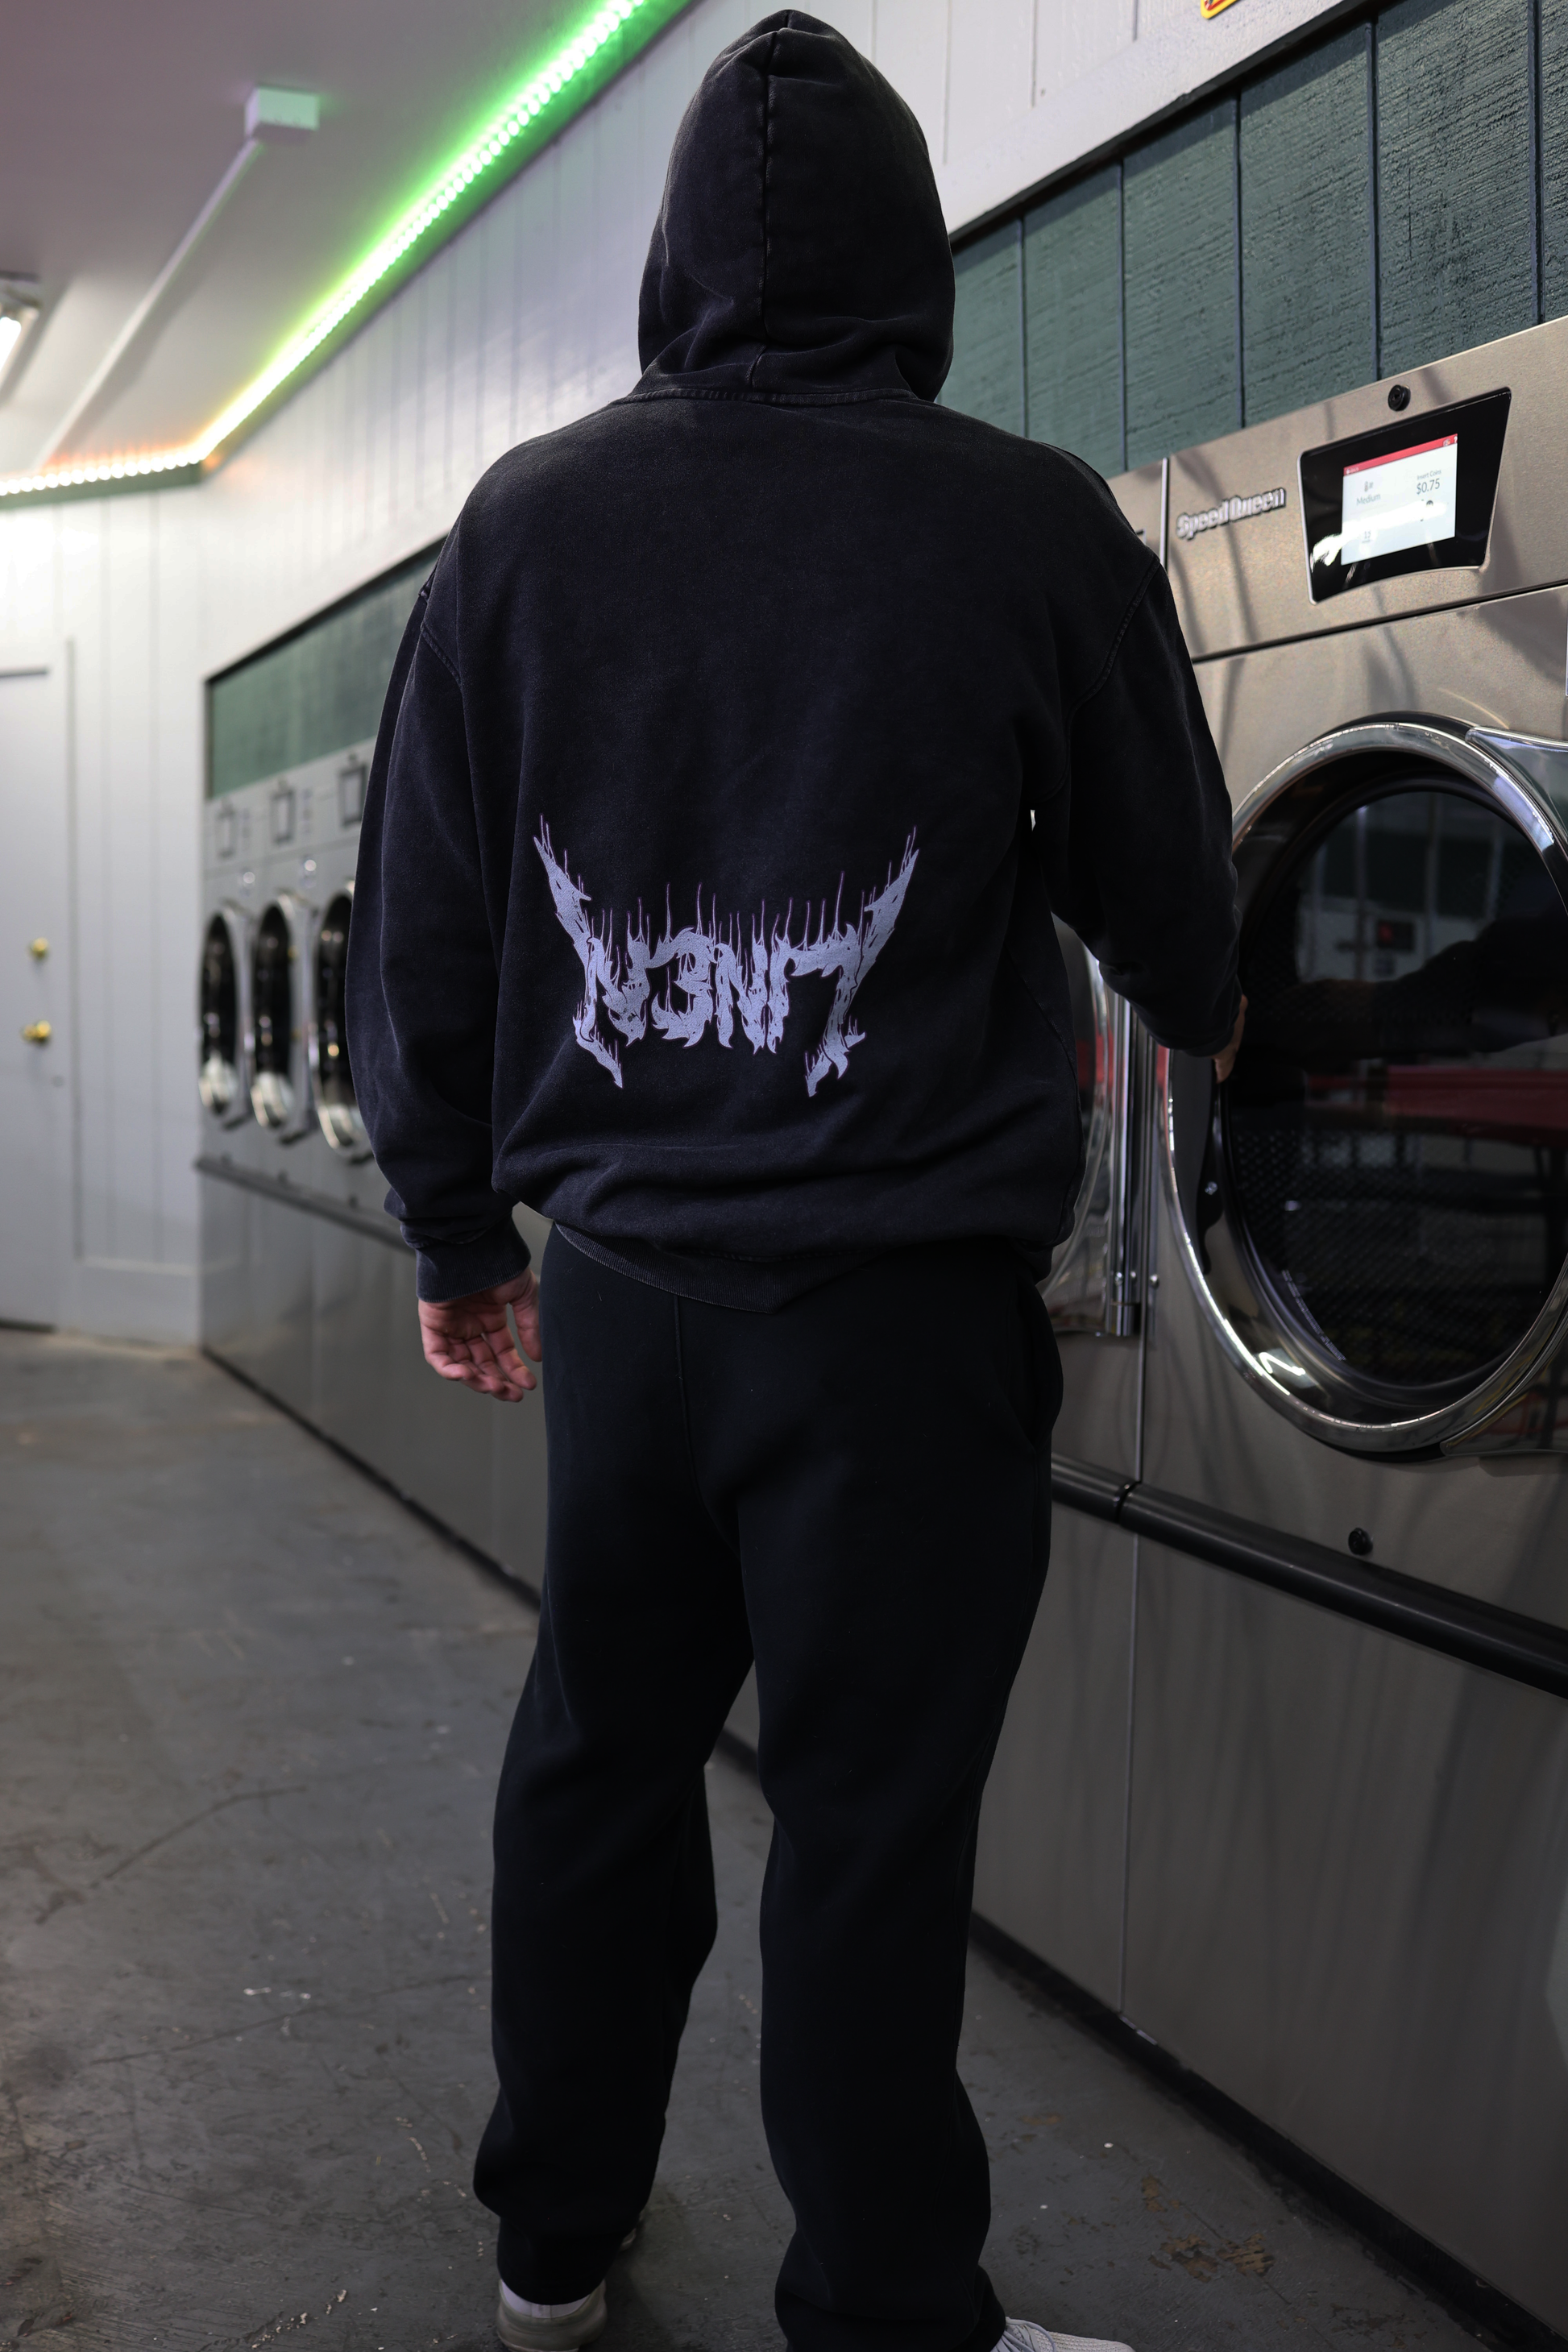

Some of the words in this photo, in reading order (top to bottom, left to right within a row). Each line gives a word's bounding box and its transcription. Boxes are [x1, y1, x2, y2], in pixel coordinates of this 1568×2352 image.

[1417, 472, 1429, 480] Insert
[1416, 478, 1441, 495] $0.75
[1356, 493, 1381, 506] Medium
